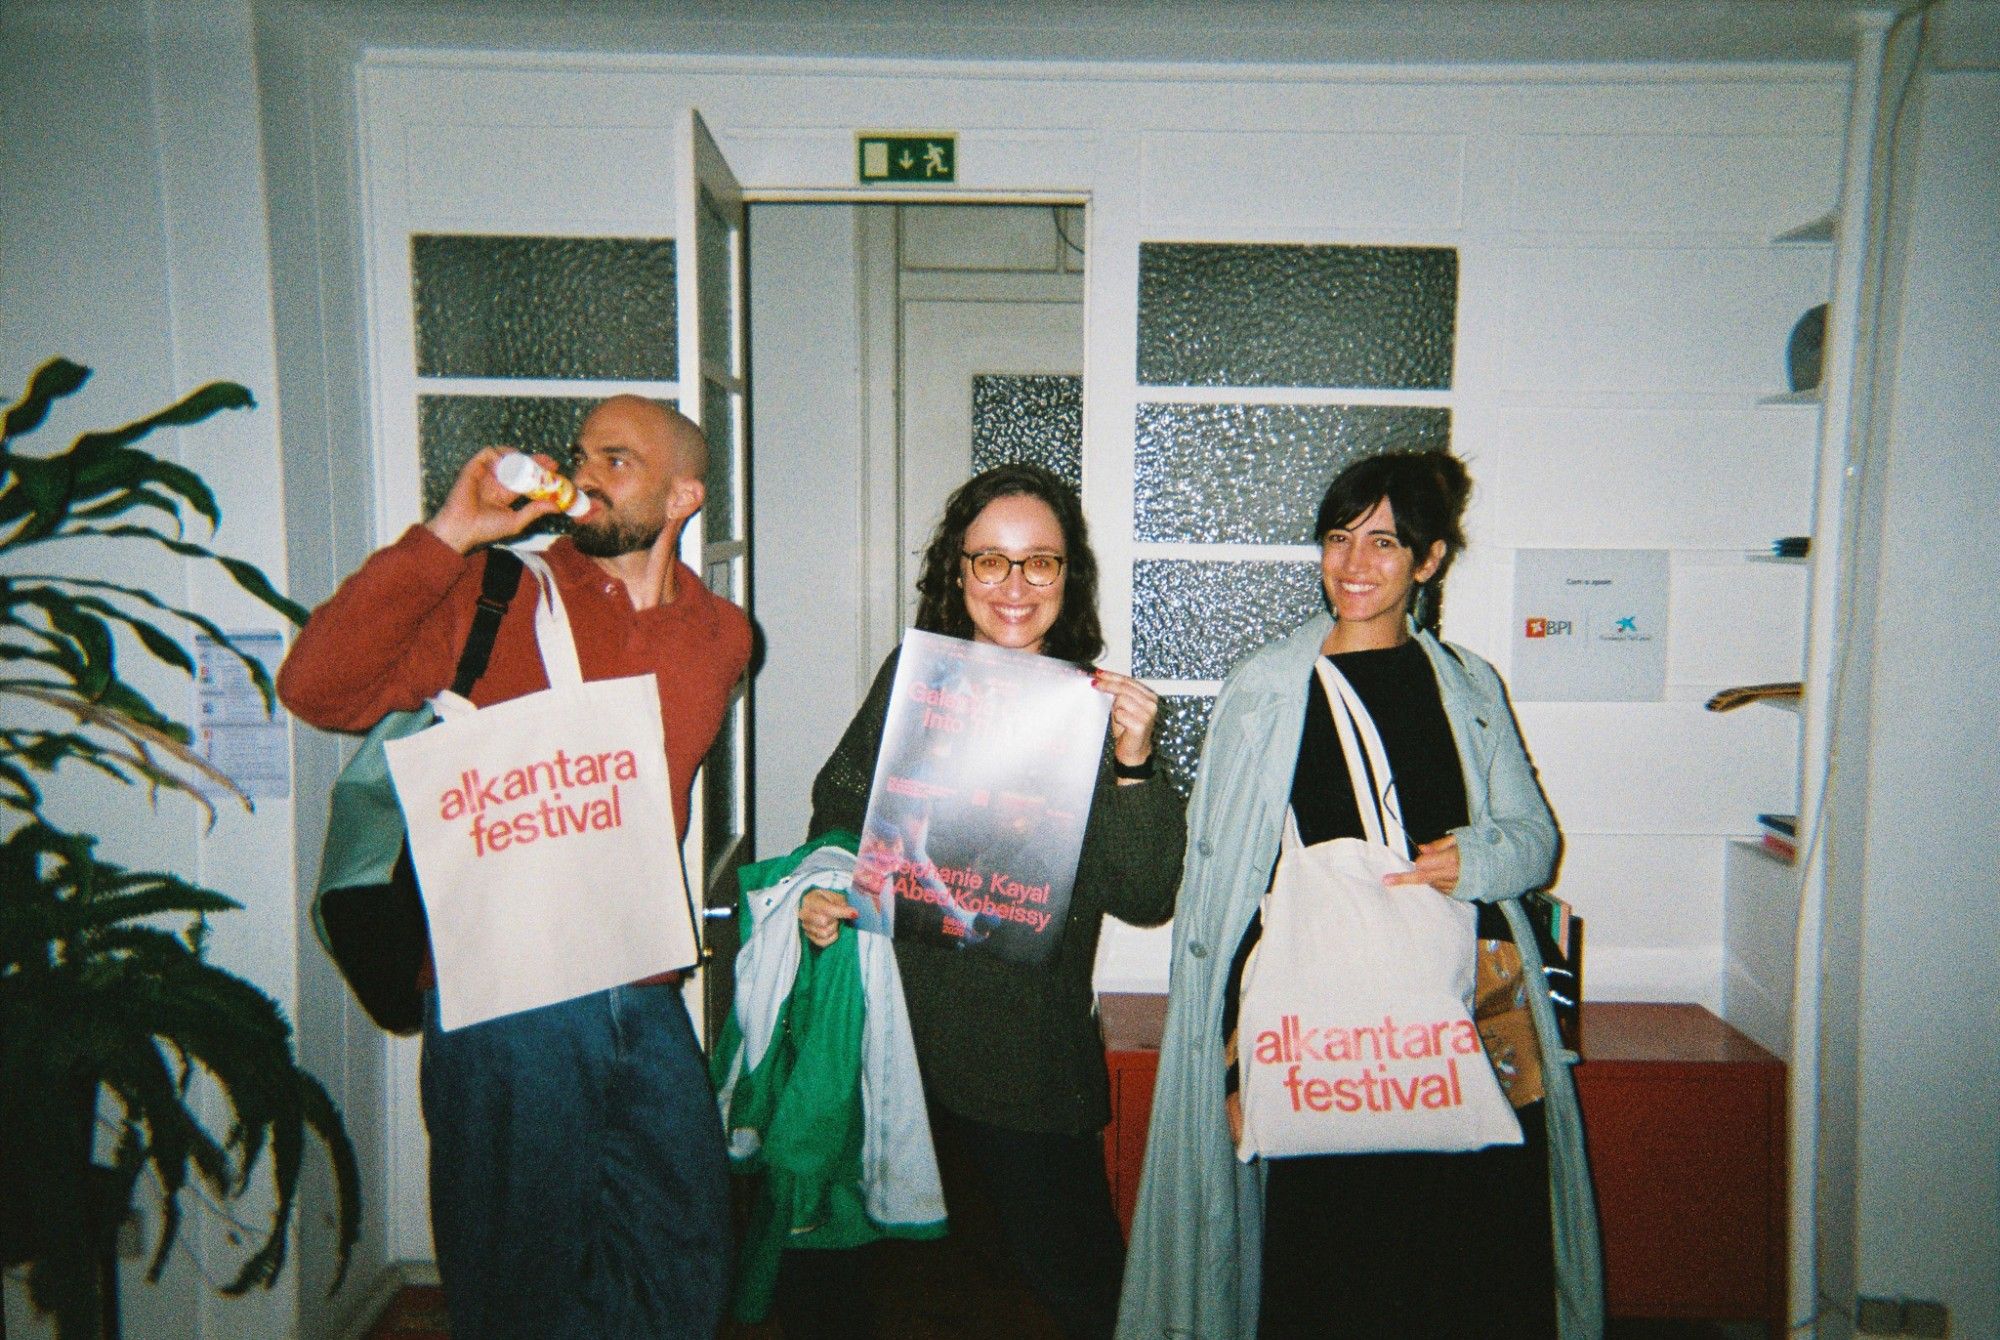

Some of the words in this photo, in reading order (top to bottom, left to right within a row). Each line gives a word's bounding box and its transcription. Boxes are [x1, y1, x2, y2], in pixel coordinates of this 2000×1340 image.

[1546, 620, 1572, 635] BPI
[439, 748, 638, 821] alkantara
[468, 783, 622, 858] festival
[894, 877, 952, 907] Abed
[954, 886, 1052, 934] Kobeissy
[990, 872, 1052, 905] Kayal
[1254, 1014, 1480, 1065] alkantara
[1283, 1056, 1463, 1112] festival
